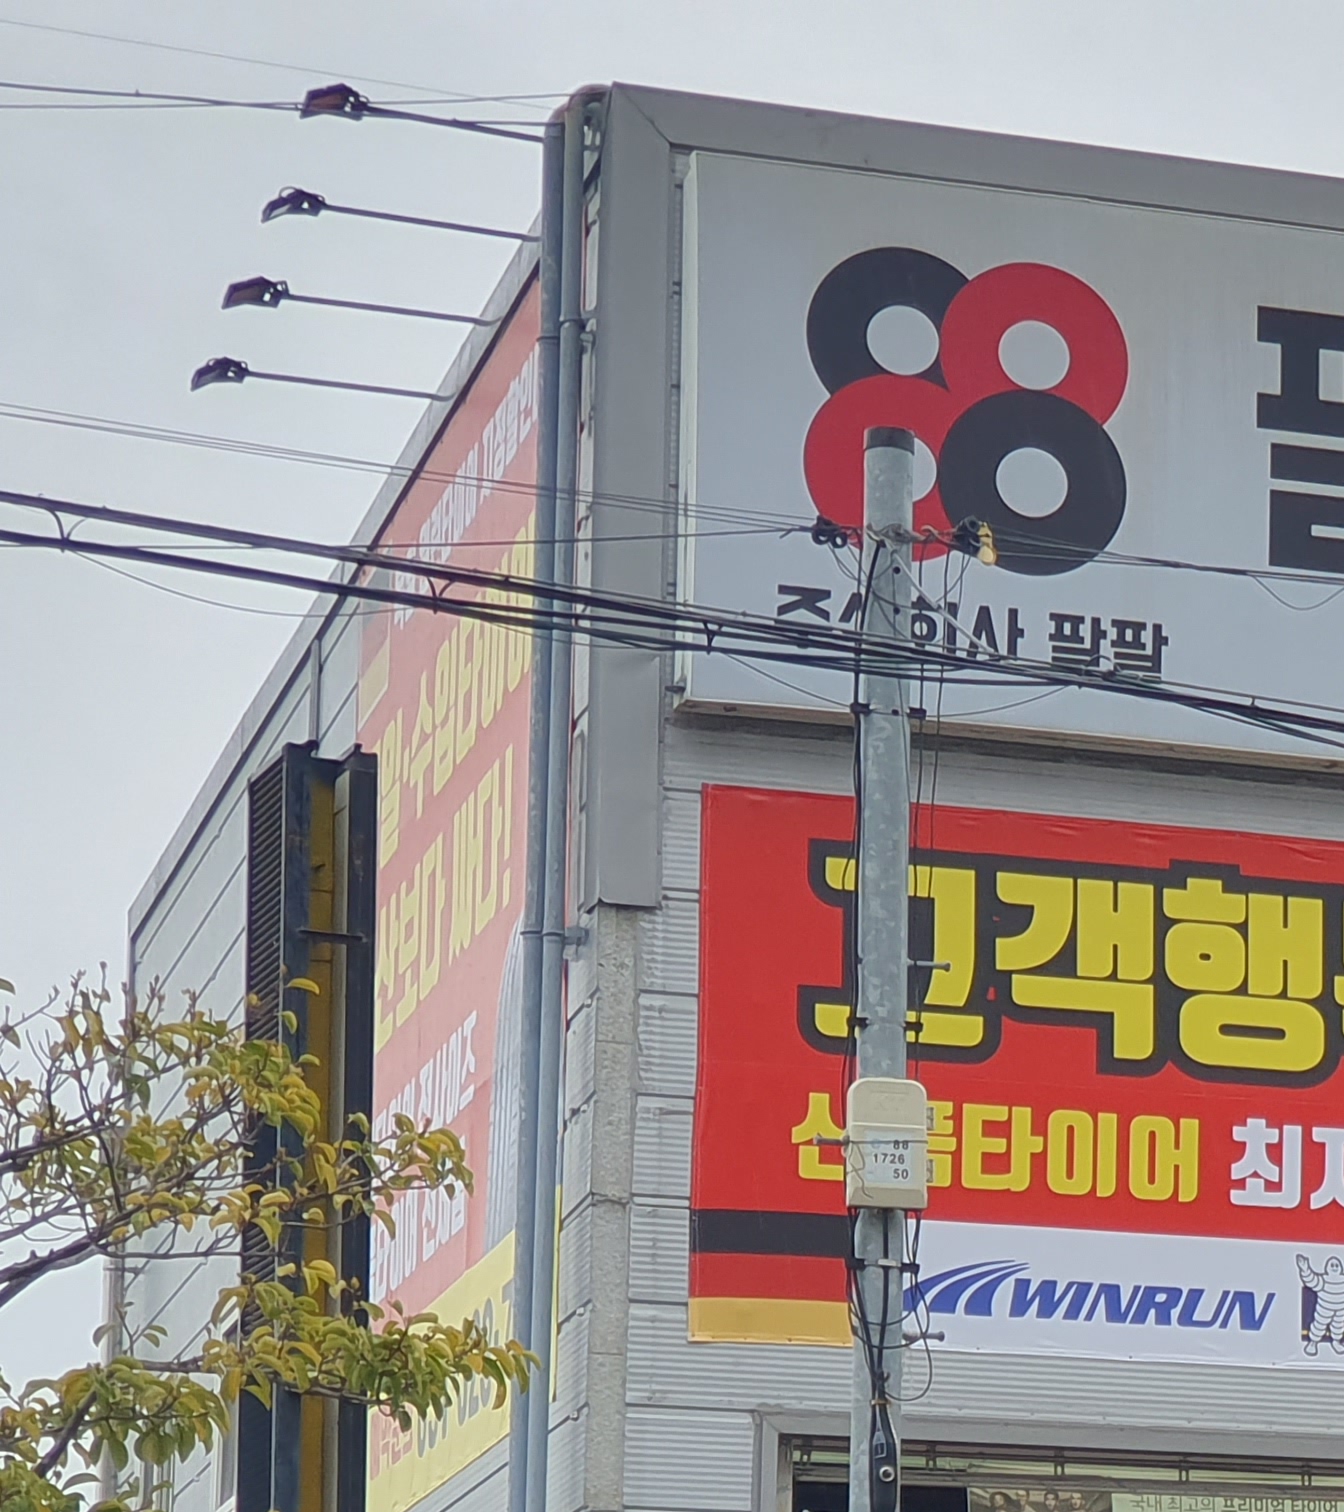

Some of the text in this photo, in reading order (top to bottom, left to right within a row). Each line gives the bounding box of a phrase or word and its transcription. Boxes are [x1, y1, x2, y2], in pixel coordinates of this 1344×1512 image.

[1048, 611, 1169, 680] 팔팔
[873, 1153, 905, 1165] 1726
[893, 1168, 909, 1180] 50
[369, 1185, 418, 1306] 타이어
[1009, 1277, 1275, 1332] WINRUN
